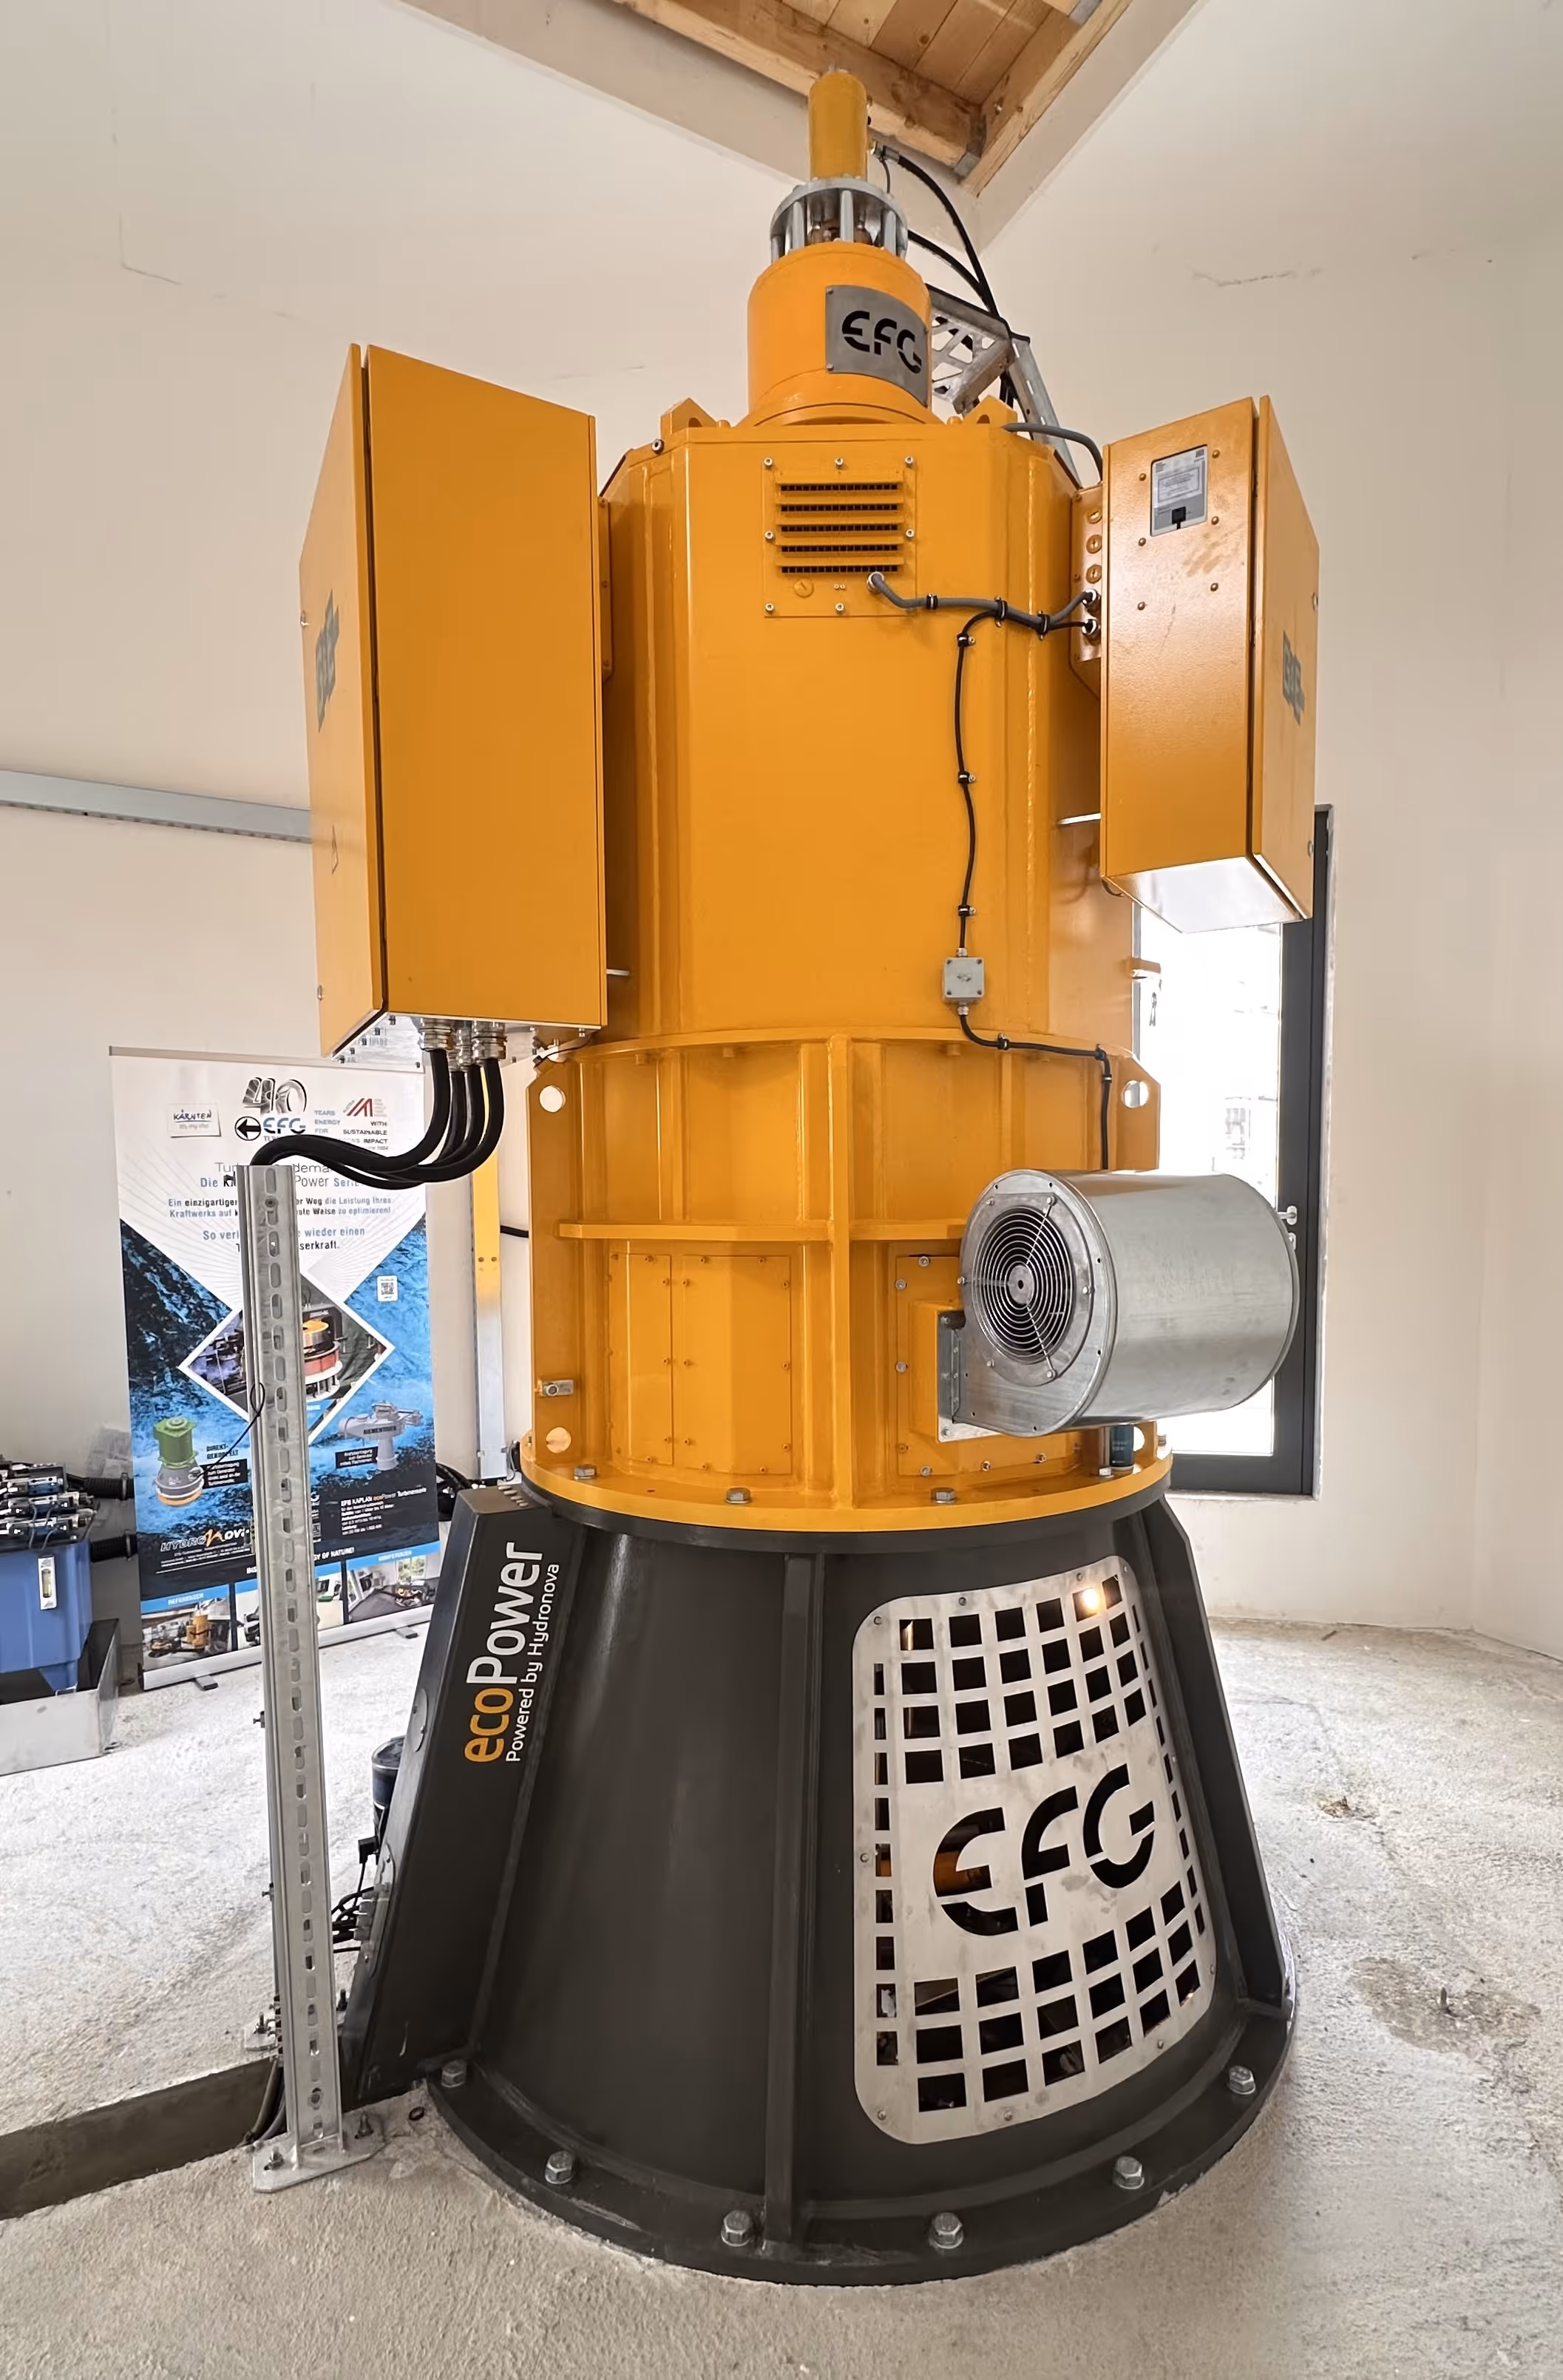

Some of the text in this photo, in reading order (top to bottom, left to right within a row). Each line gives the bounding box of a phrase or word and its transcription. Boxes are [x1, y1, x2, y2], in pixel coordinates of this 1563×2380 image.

[841, 310, 923, 375] EFG
[262, 1116, 307, 1135] EFG
[200, 1178, 219, 1188] Die
[168, 1199, 183, 1207] Ein
[306, 1197, 323, 1206] Weg
[325, 1197, 337, 1205] die
[339, 1196, 370, 1206] Leistung
[169, 1209, 217, 1218] Kraftwerks
[219, 1209, 232, 1218] auf
[312, 1207, 336, 1216] Weise
[203, 1230, 217, 1241] So
[304, 1227, 337, 1238] wieder
[339, 1227, 365, 1237] einen
[299, 1240, 340, 1251] serkraft.
[464, 1542, 543, 1763] ecoPower
[506, 1564, 560, 1762] Powered by Hydronova
[932, 1763, 1155, 1936] EFG
